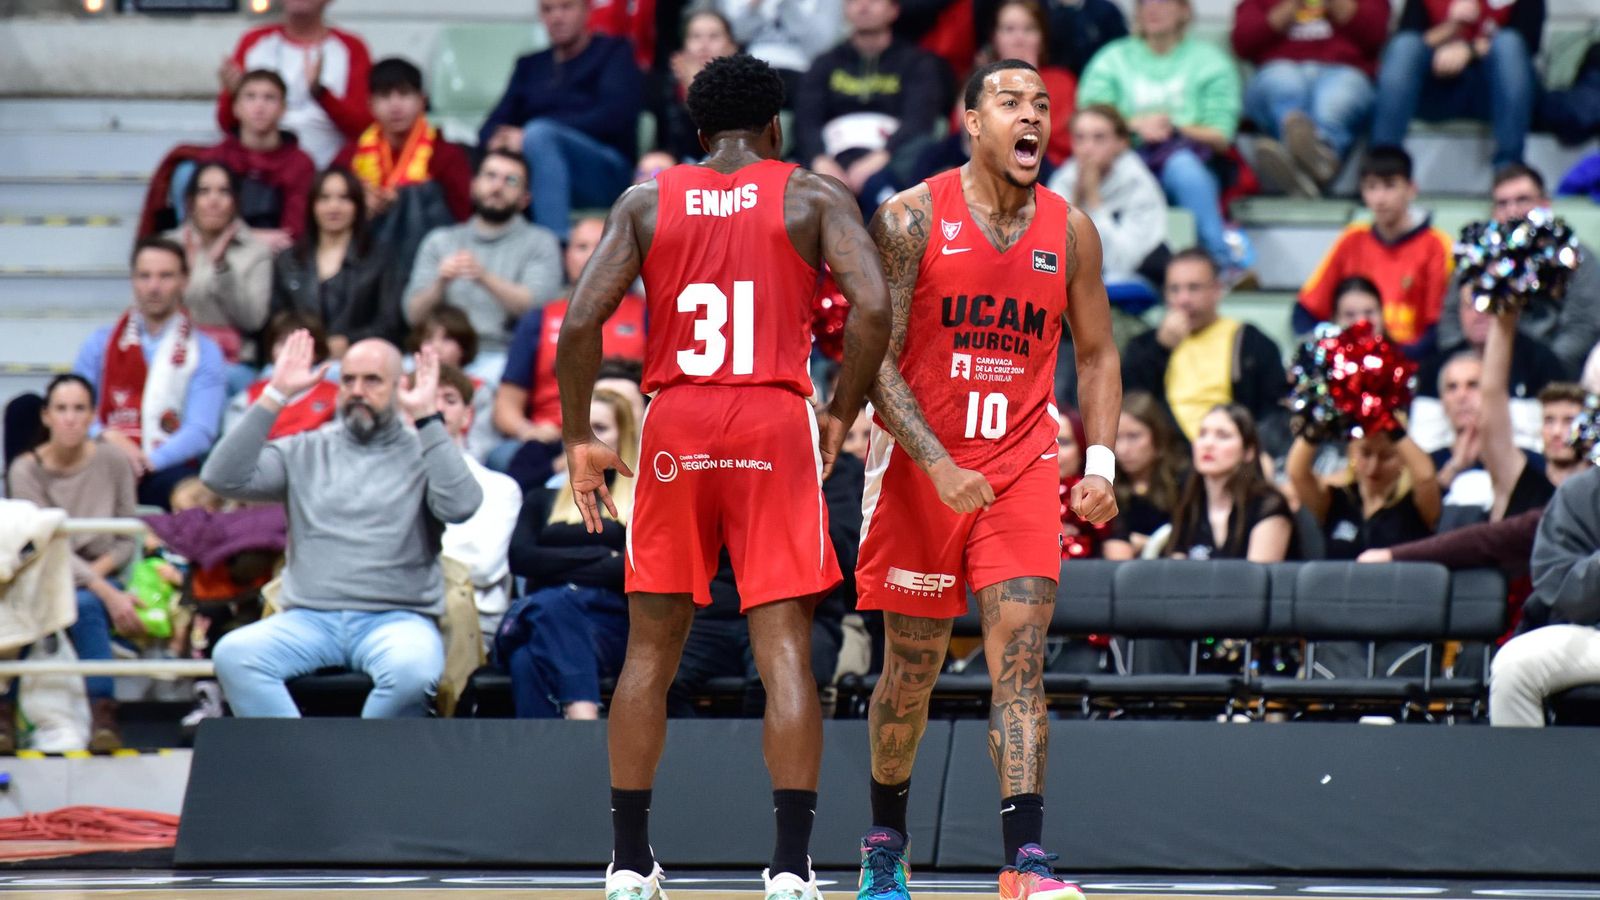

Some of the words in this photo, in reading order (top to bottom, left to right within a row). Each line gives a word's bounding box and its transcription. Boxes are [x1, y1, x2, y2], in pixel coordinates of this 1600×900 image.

[685, 183, 758, 217] ENNIS
[676, 280, 754, 376] 31
[941, 294, 1047, 341] UCAM
[953, 331, 1030, 358] MURCIA
[976, 357, 1013, 366] CARAVACA
[993, 366, 1010, 374] CRUZ
[1010, 367, 1025, 375] 2024
[974, 372, 988, 381] AÑO
[964, 391, 1009, 439] 10
[681, 459, 718, 471] REGIÓN
[720, 459, 734, 468] DE
[736, 459, 773, 471] MURCIA
[883, 582, 942, 598] SOLUTIONS
[894, 569, 956, 593] ESP
